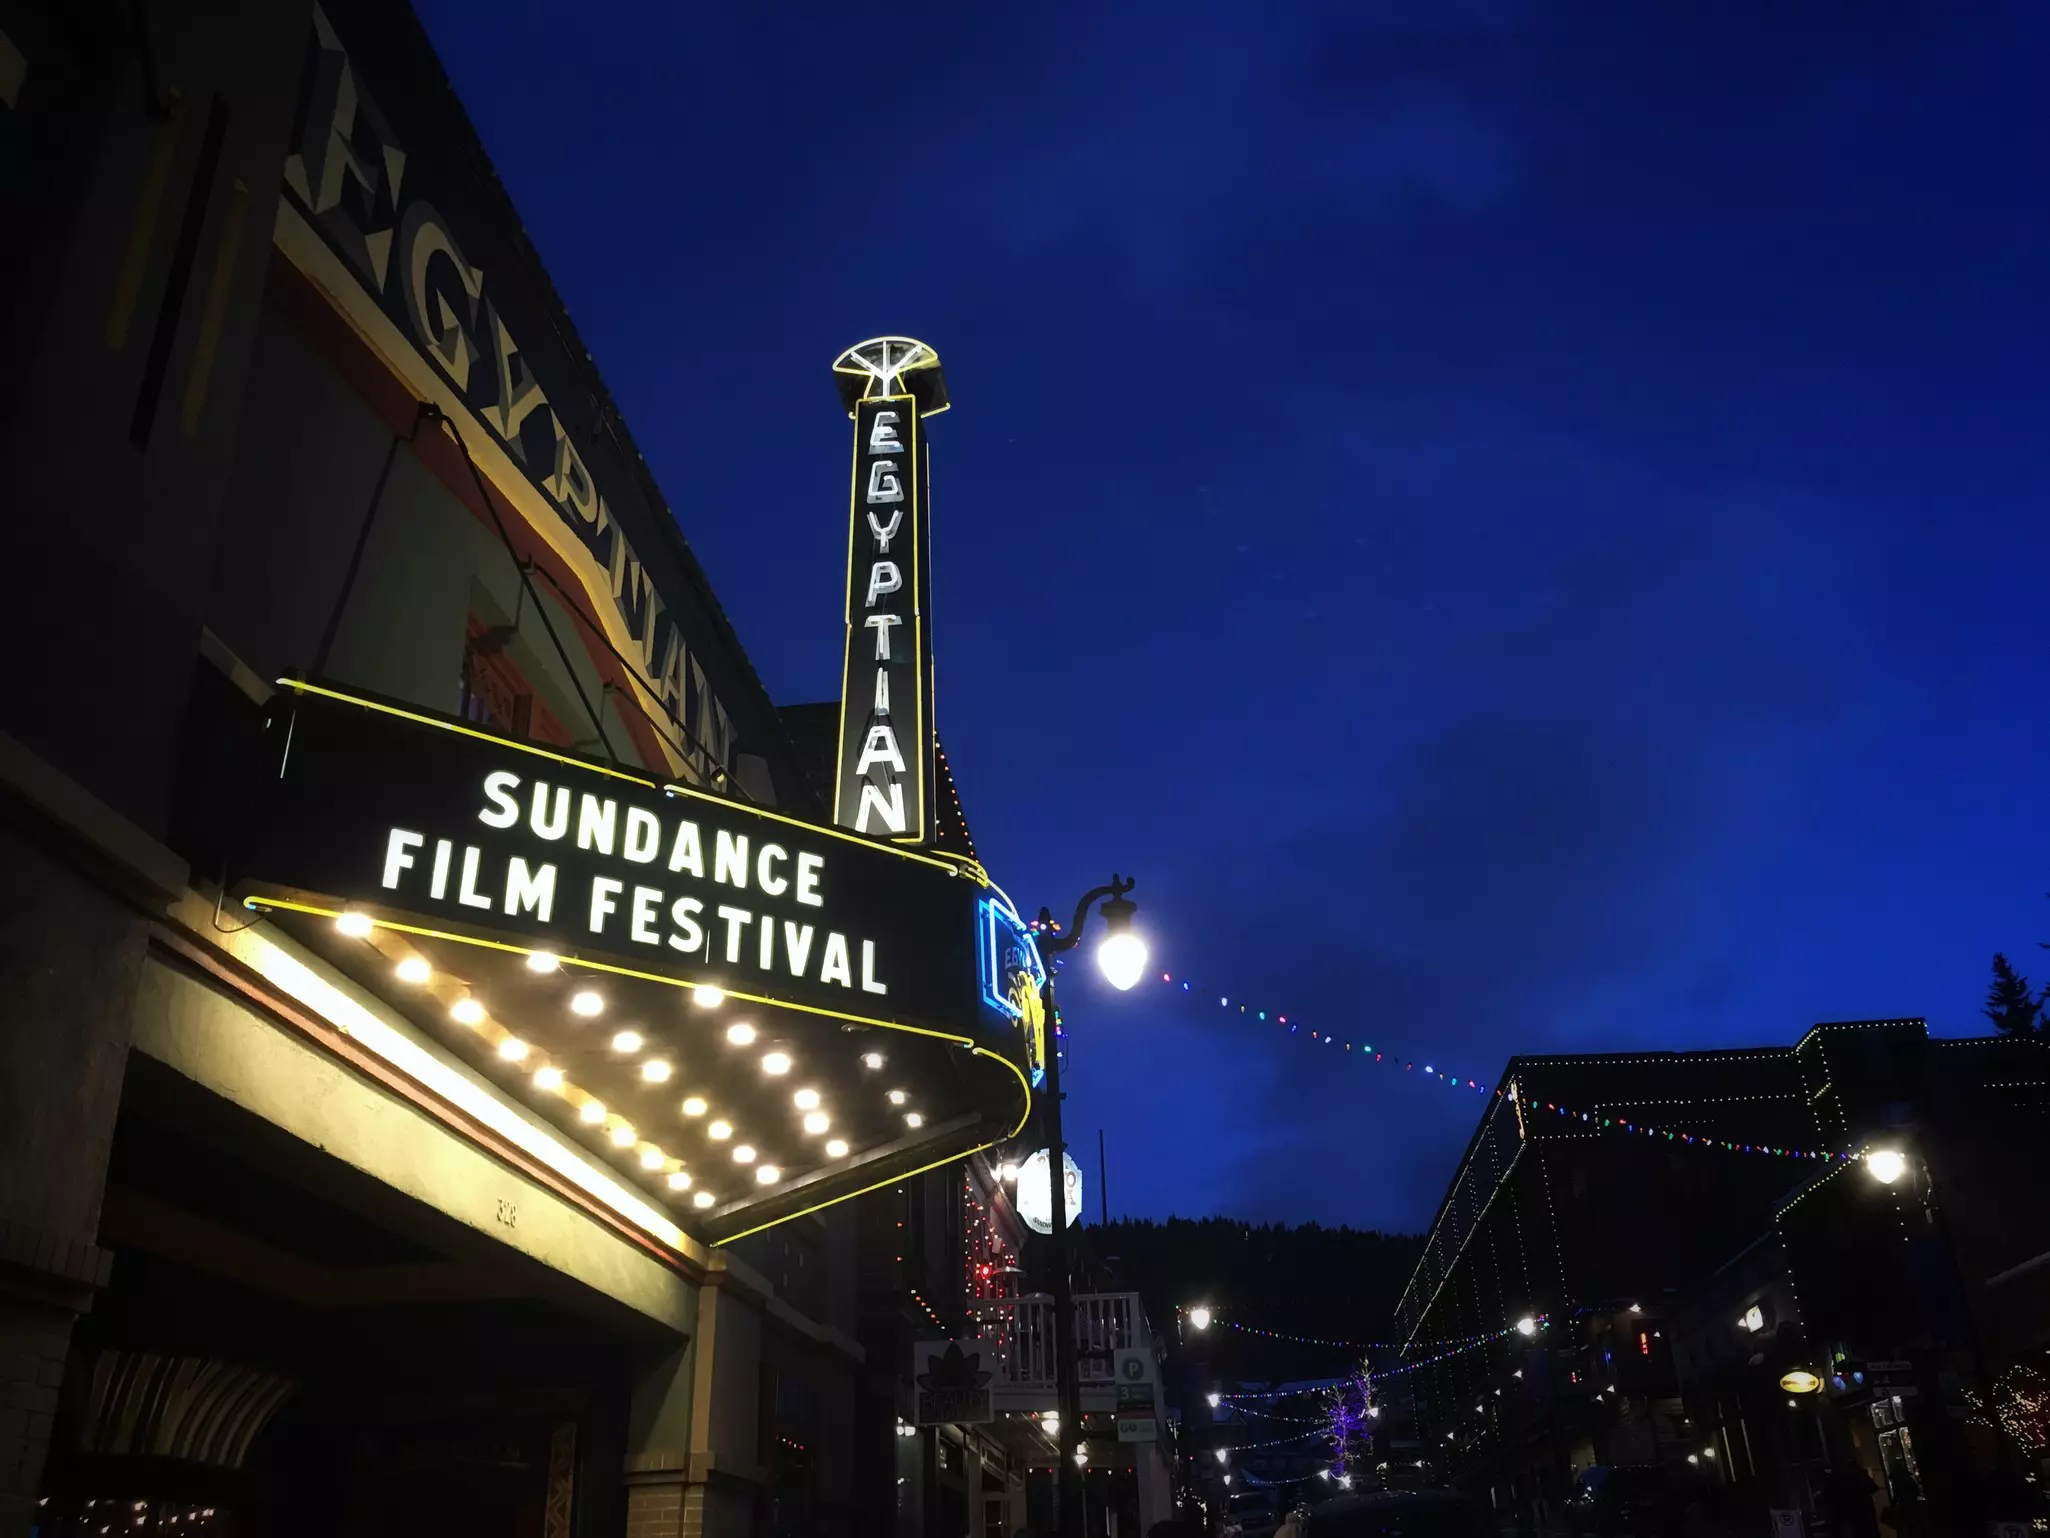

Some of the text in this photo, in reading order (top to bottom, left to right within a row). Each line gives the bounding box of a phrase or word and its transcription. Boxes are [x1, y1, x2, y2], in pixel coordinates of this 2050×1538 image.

[282, 0, 738, 793] EGYPTIAN
[854, 410, 907, 833] EGYPTIAN
[381, 828, 888, 995] FILM FESTIVAL
[477, 770, 825, 907] SUNDANCE
